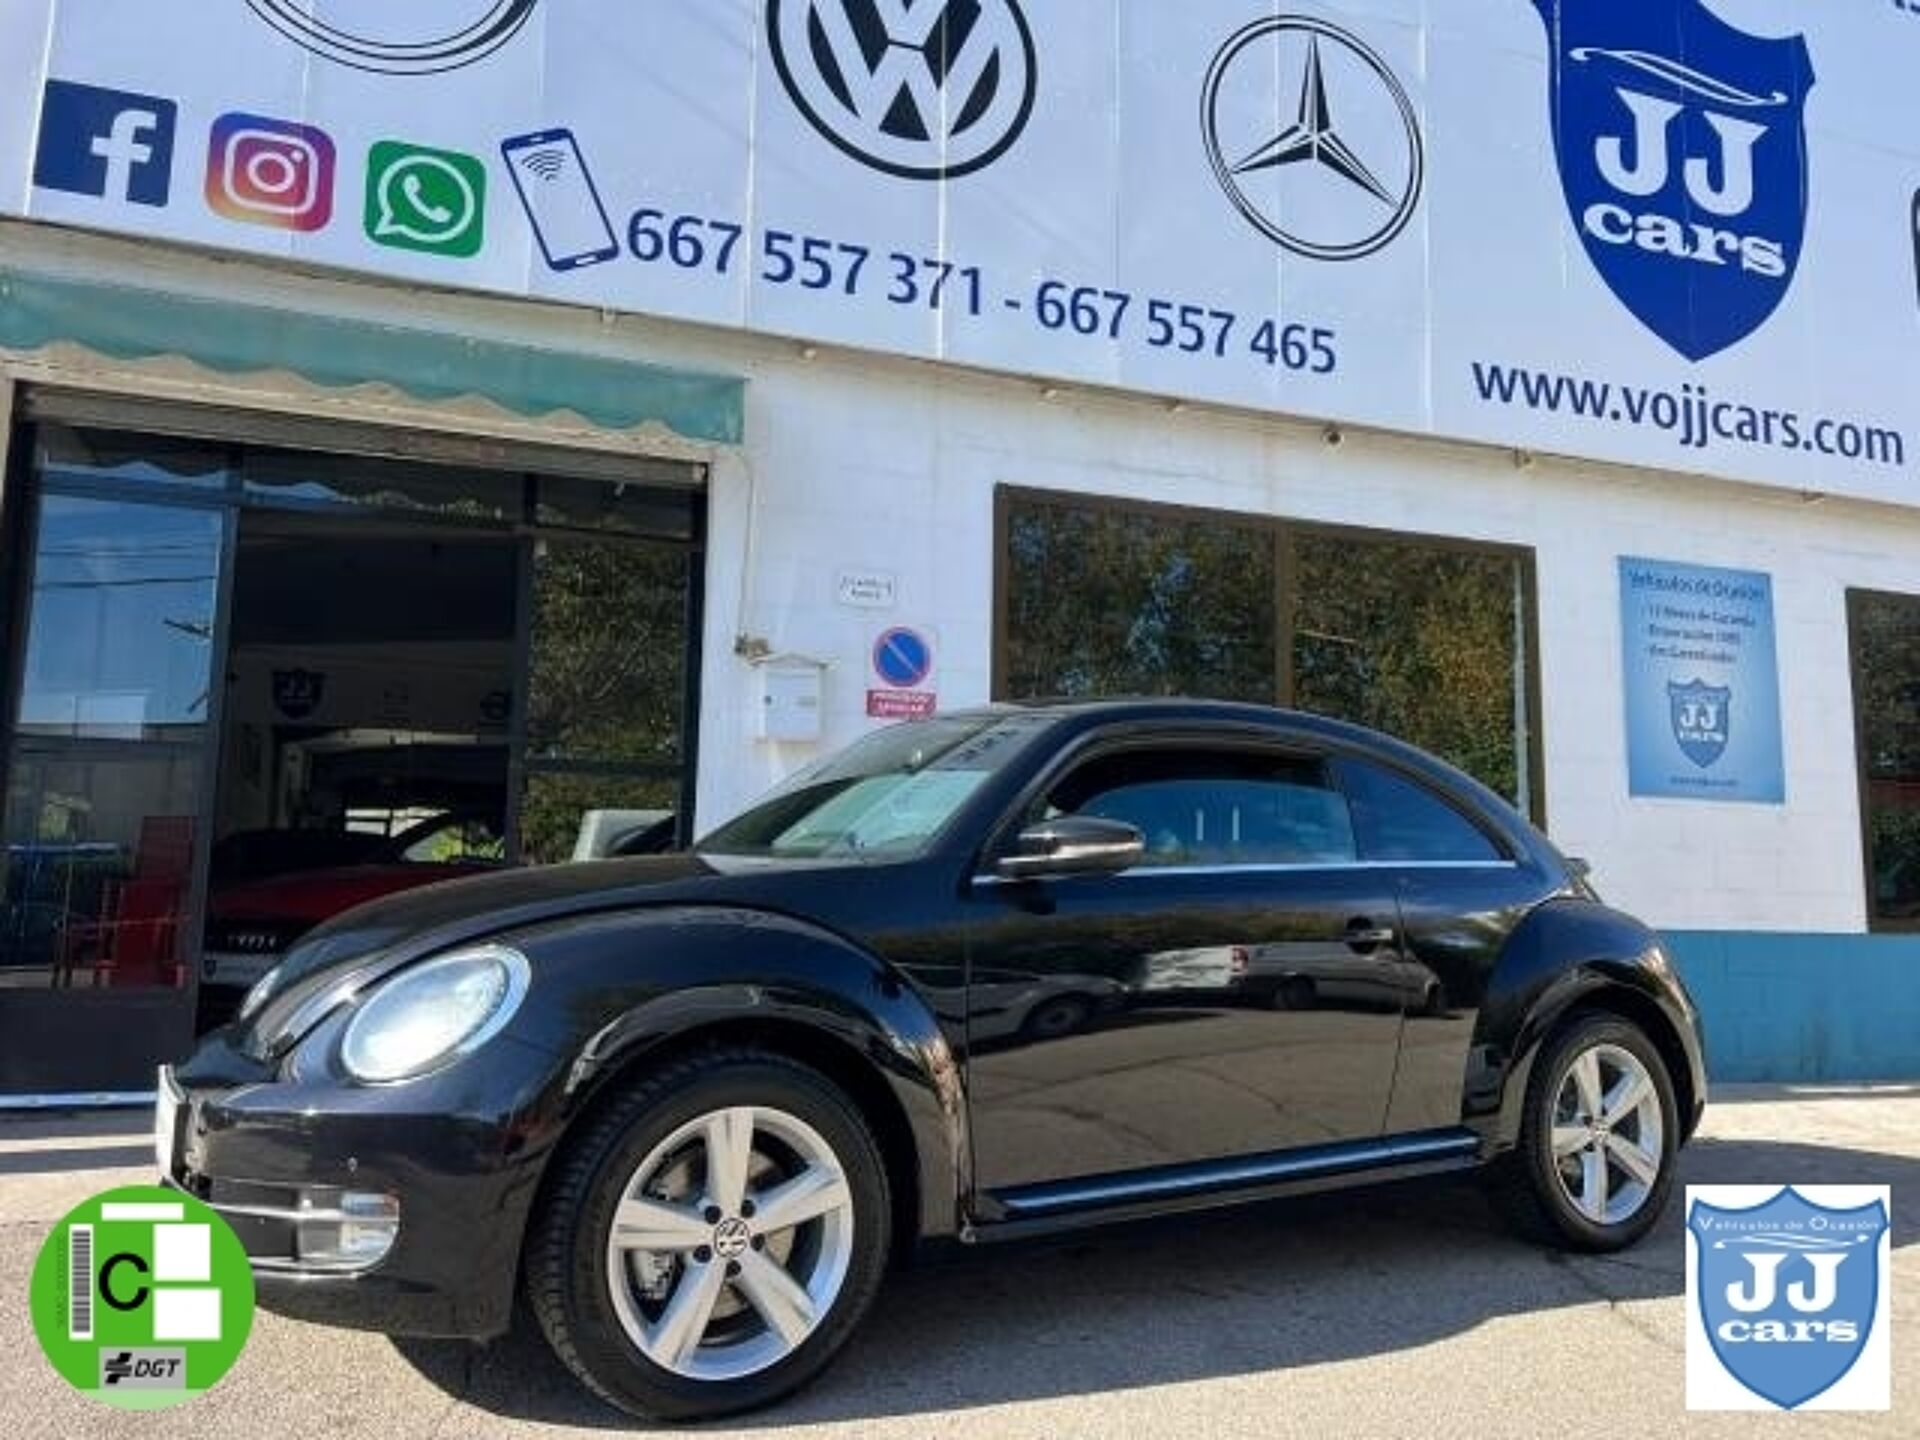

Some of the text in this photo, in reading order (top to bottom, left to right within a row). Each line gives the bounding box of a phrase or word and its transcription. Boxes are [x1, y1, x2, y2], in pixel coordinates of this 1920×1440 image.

[1595, 86, 1769, 216] JJ
[627, 208, 742, 274] 667
[762, 229, 870, 295] 557
[887, 252, 982, 316] 371
[1036, 280, 1130, 339] 667
[1148, 298, 1236, 358] 557
[1250, 319, 1336, 374] 465
[1583, 203, 1787, 277] cars
[1472, 362, 1905, 465] www.vojjcars.com
